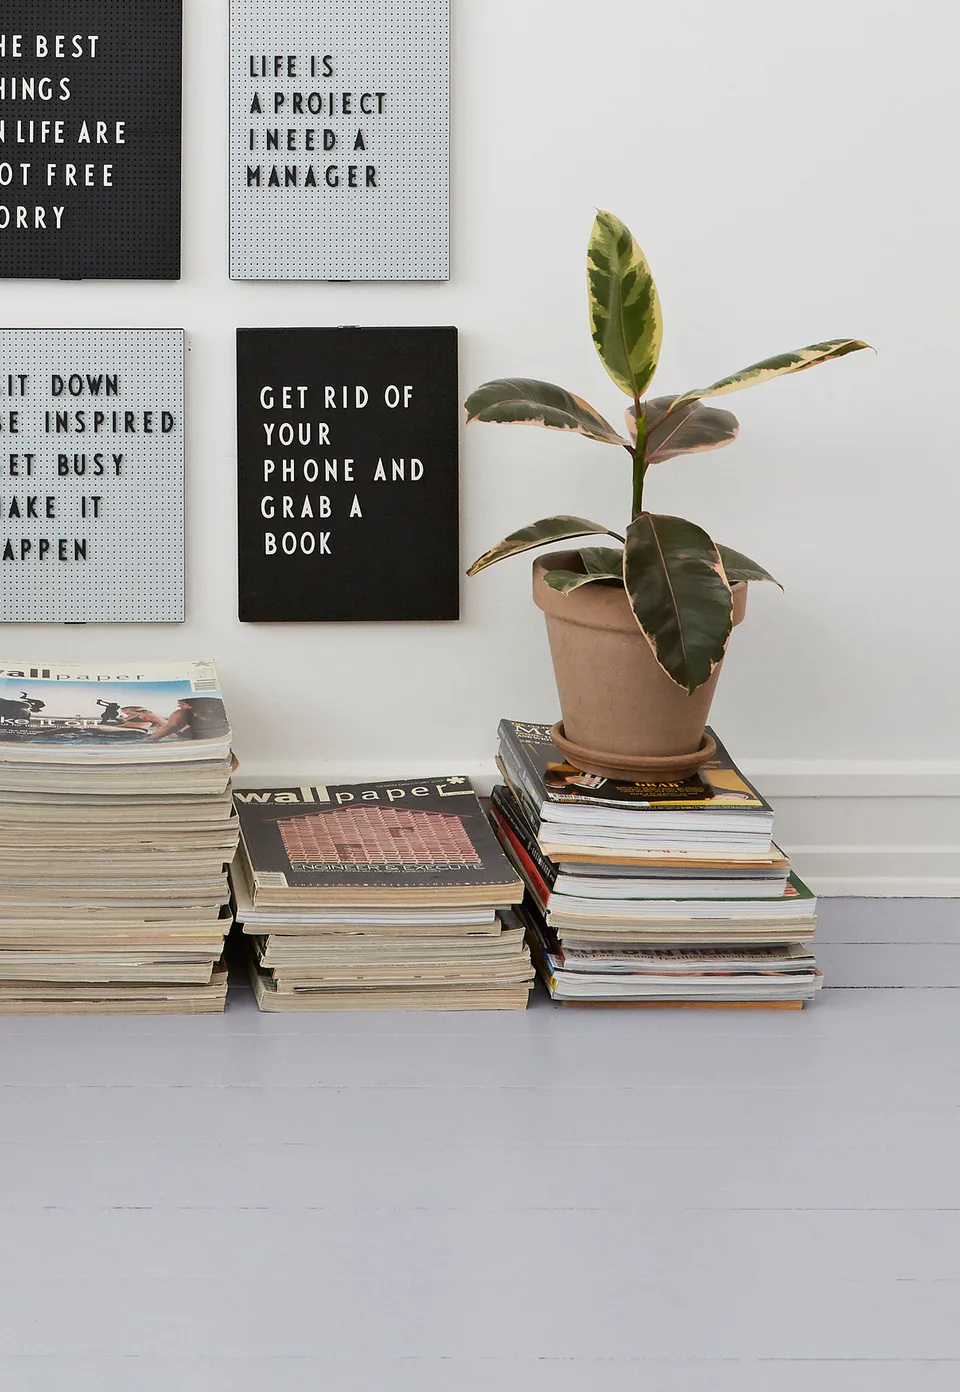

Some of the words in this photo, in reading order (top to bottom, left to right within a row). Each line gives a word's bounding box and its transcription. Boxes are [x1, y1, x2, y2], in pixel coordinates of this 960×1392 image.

[36, 34, 99, 58] BEST
[249, 55, 297, 78] LIFE
[310, 54, 333, 78] IS
[249, 91, 262, 114] A
[274, 91, 387, 117] PROJECT
[16, 120, 65, 144] LIFE
[77, 119, 126, 144] ARE
[249, 128, 255, 151] I
[266, 128, 336, 151] NEED
[353, 128, 366, 151] A
[47, 163, 113, 187] FREE
[246, 164, 377, 188] MANAGER
[51, 373, 118, 397] DOWN
[259, 385, 308, 410] GET
[324, 385, 369, 409] RID
[384, 384, 413, 409] OF
[45, 410, 174, 434] INSPIRED
[263, 422, 331, 446] YOUR
[57, 452, 123, 477] BUSY
[264, 458, 354, 483] PHONE
[373, 457, 424, 482] AND
[81, 495, 103, 519] IT
[260, 494, 332, 519] GRAB
[349, 493, 363, 518] A
[265, 531, 332, 555] BOOK
[291, 863, 380, 871] ENGINEER
